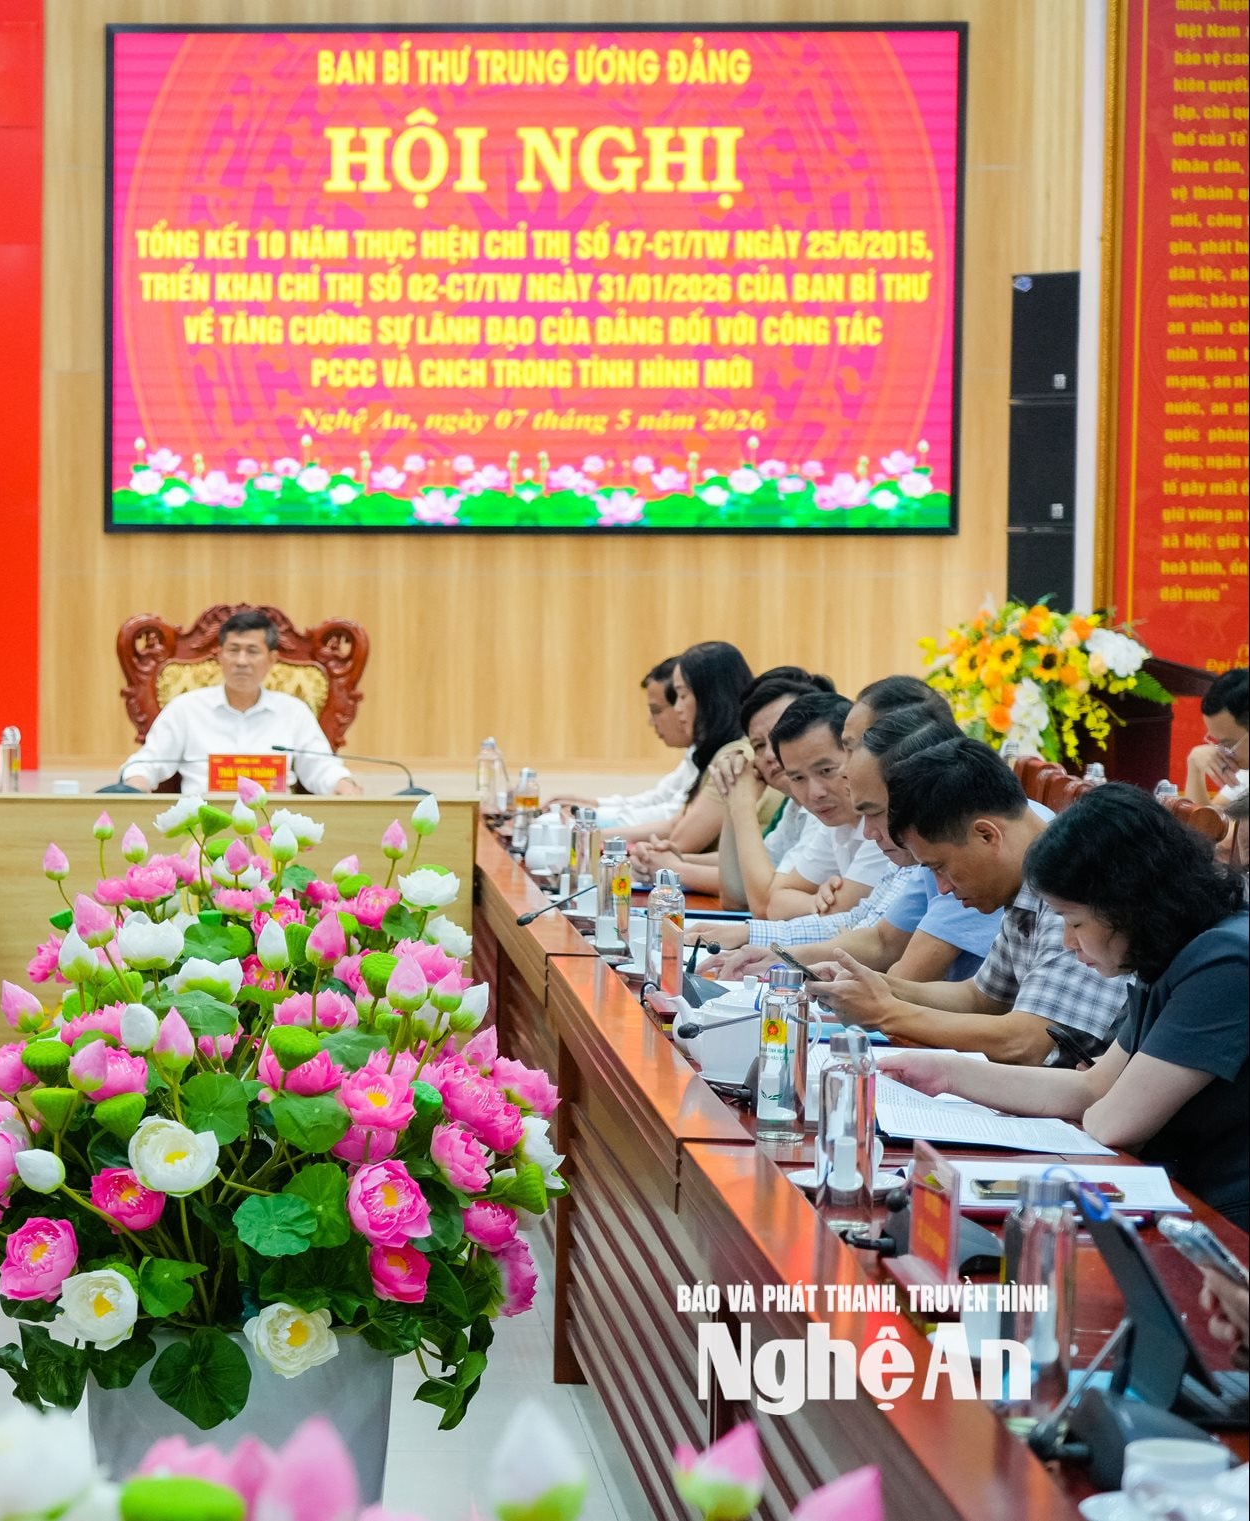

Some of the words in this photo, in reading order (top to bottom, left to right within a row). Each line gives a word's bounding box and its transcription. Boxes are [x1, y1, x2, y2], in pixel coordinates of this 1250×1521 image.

[317, 49, 377, 86] BAN
[381, 40, 412, 86] BÍ
[414, 44, 472, 86] THƯ
[474, 47, 570, 86] TRUNG
[575, 44, 661, 86] ƯƠNG
[665, 37, 752, 86] ĐẢNG
[322, 106, 489, 210] HỘI
[515, 124, 745, 212] NGHỊ
[134, 219, 201, 259] TỔNG
[202, 222, 252, 260] KẾT
[254, 228, 287, 260] 10
[289, 226, 351, 259] NĂM
[353, 227, 418, 266] THỰC
[419, 223, 482, 266] HIỆN
[483, 222, 527, 260] CHỈ
[531, 230, 571, 265] THỊ
[575, 222, 612, 261] SỐ
[613, 229, 731, 262] 47-CT/TW
[732, 224, 802, 261] NGÀY
[804, 229, 934, 262] 25/6/2015,
[139, 262, 210, 303] TRIỂN
[215, 271, 273, 303] KHAI
[277, 263, 322, 304] CHỈ
[324, 272, 364, 308] THỊ
[368, 261, 403, 304] SỐ
[407, 271, 523, 304] 02-CT/TW
[527, 267, 594, 304] NGÀY
[597, 271, 732, 304] 31/01/2026
[736, 265, 789, 304] CỦA
[792, 272, 846, 304] BAN
[851, 266, 877, 304] BÍ
[881, 270, 932, 304] THƯ
[220, 310, 284, 346] TĂNG
[377, 313, 414, 353] SỰ
[415, 310, 481, 346] LÃNH
[485, 316, 536, 351] ĐẠO
[540, 308, 591, 347] CỦA
[594, 307, 664, 347] ĐẢNG
[668, 306, 712, 347] ĐỐI
[762, 310, 830, 347] CÔNG
[834, 310, 883, 346] TÁC
[310, 357, 378, 389] PCCC
[381, 352, 417, 388] VÀ
[418, 357, 489, 389] CNCH
[490, 358, 574, 389] TRONG
[575, 353, 636, 389] TÌNH
[638, 354, 700, 389] HÌNH
[296, 407, 367, 436] Nghệ
[369, 409, 419, 433] An,
[424, 408, 488, 435] ngày
[493, 407, 527, 430] 07
[532, 408, 609, 436] tháng
[615, 408, 632, 431] 5
[637, 410, 697, 432] năm
[701, 408, 767, 433] 2026
